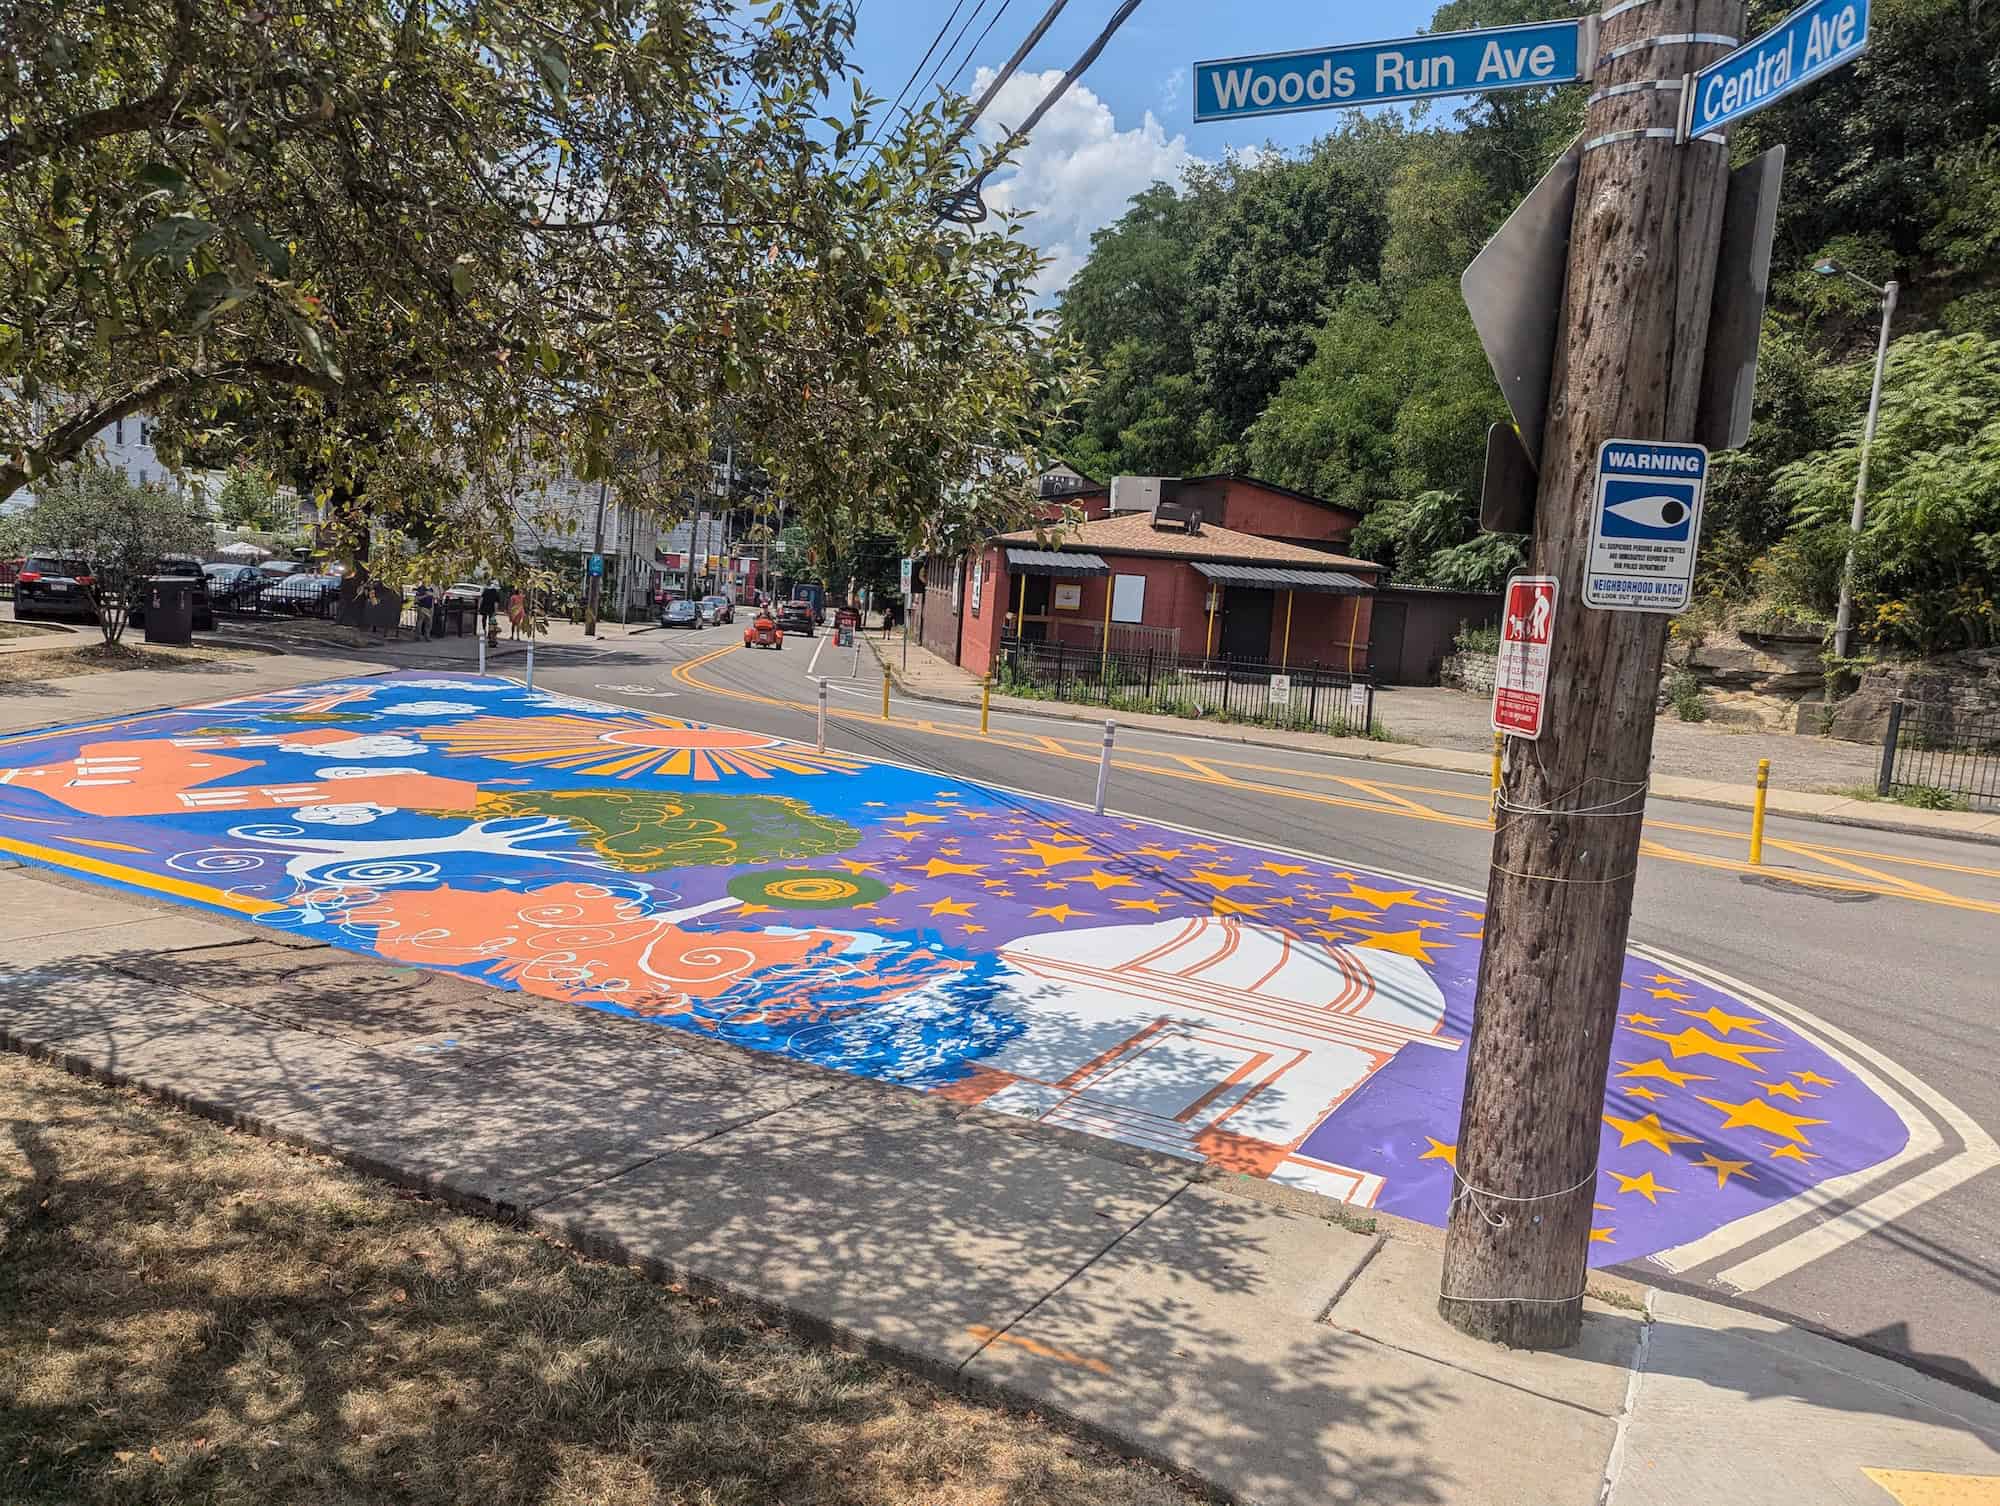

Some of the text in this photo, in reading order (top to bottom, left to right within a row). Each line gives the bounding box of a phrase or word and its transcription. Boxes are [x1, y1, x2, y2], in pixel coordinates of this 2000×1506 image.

[1703, 5, 1856, 122] Central Ave
[1211, 40, 1556, 110] Woods Run Ave
[1608, 451, 1700, 473] WARNING
[1608, 543, 1632, 551] SUSPICIOUS
[1623, 562, 1638, 570] POLICE
[1638, 563, 1667, 571] DEPARTMENT
[1593, 579, 1684, 595] NEIGHBORHOOD WATCH
